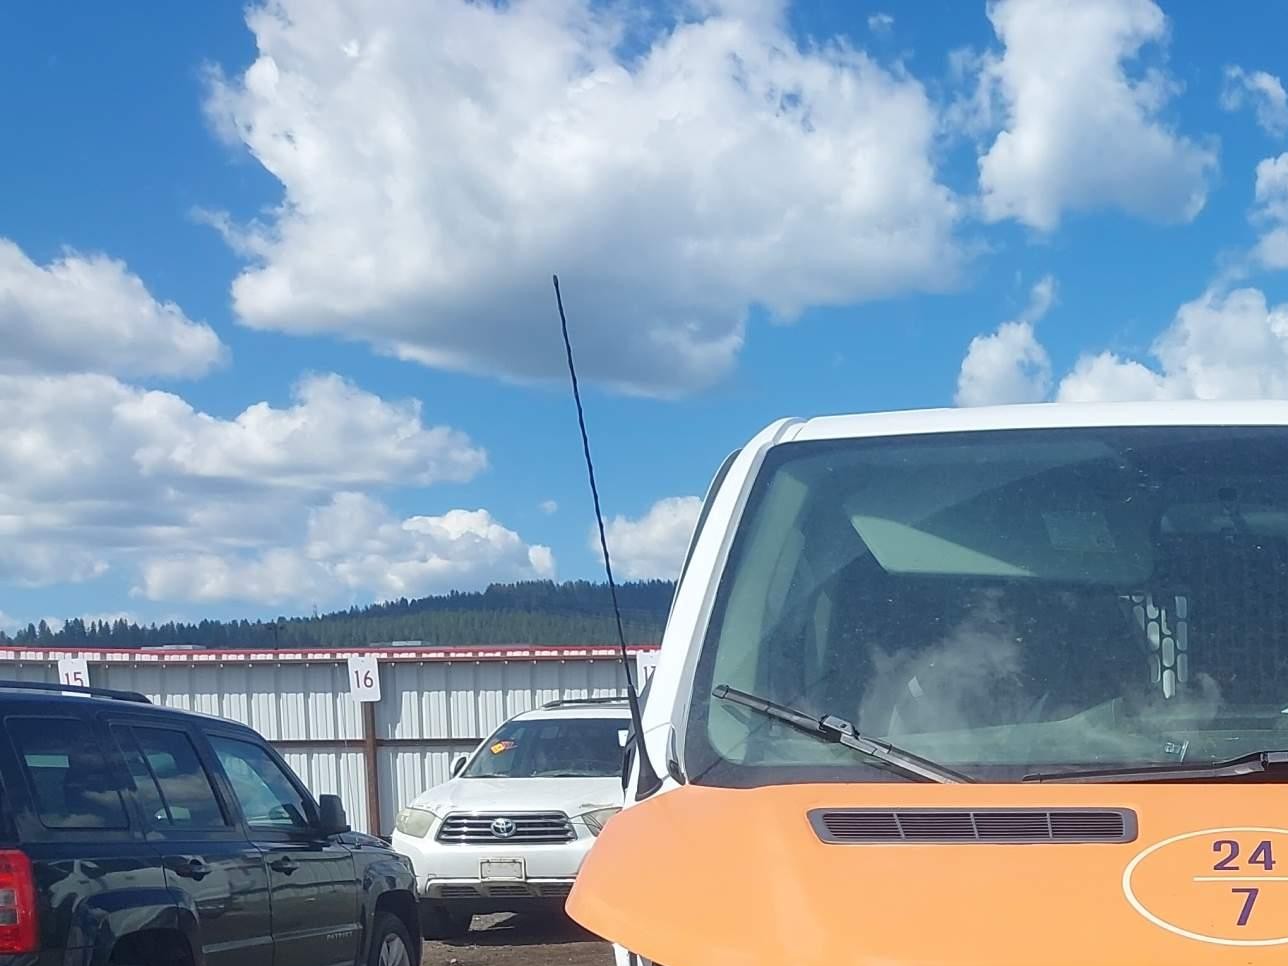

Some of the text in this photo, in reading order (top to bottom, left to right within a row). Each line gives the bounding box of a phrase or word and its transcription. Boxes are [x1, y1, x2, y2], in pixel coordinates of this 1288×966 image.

[64, 671, 84, 687] 15
[354, 669, 374, 689] 16
[1212, 839, 1277, 871] 24
[1231, 888, 1260, 927] 7
